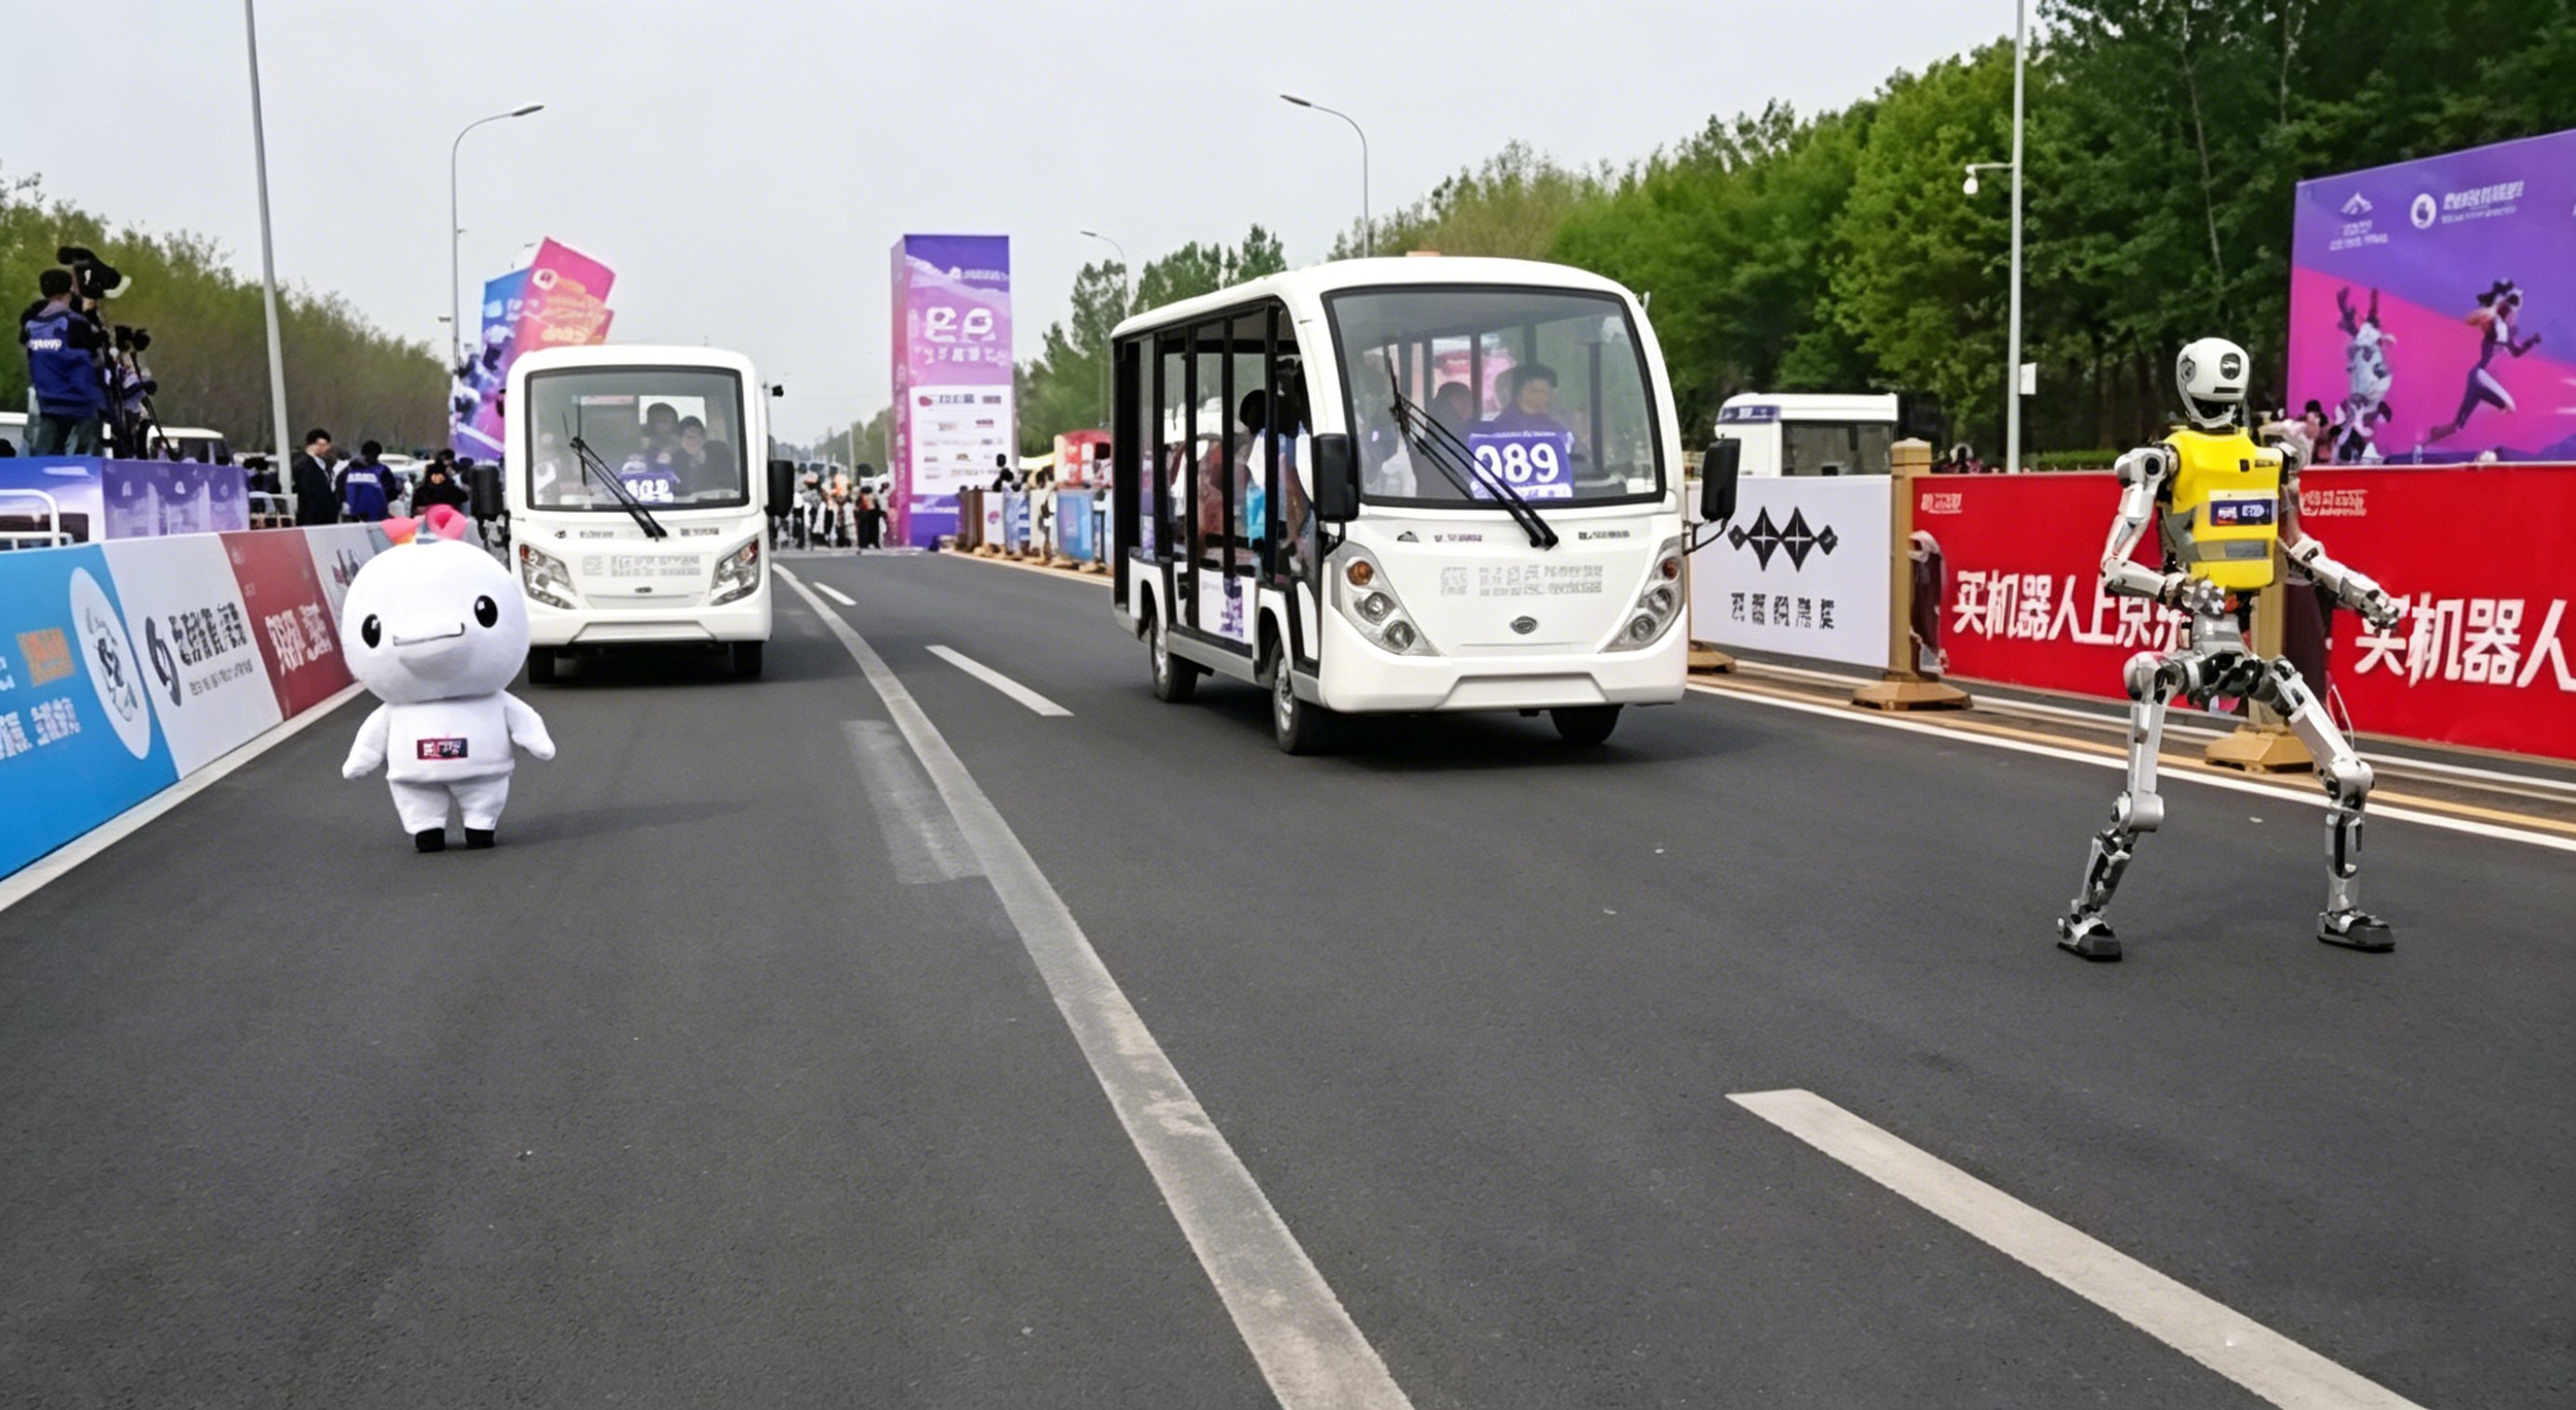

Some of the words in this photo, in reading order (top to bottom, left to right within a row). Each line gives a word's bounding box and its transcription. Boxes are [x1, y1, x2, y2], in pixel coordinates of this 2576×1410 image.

[1474, 442, 1559, 483] 089
[2353, 592, 2576, 692] 买机器人
